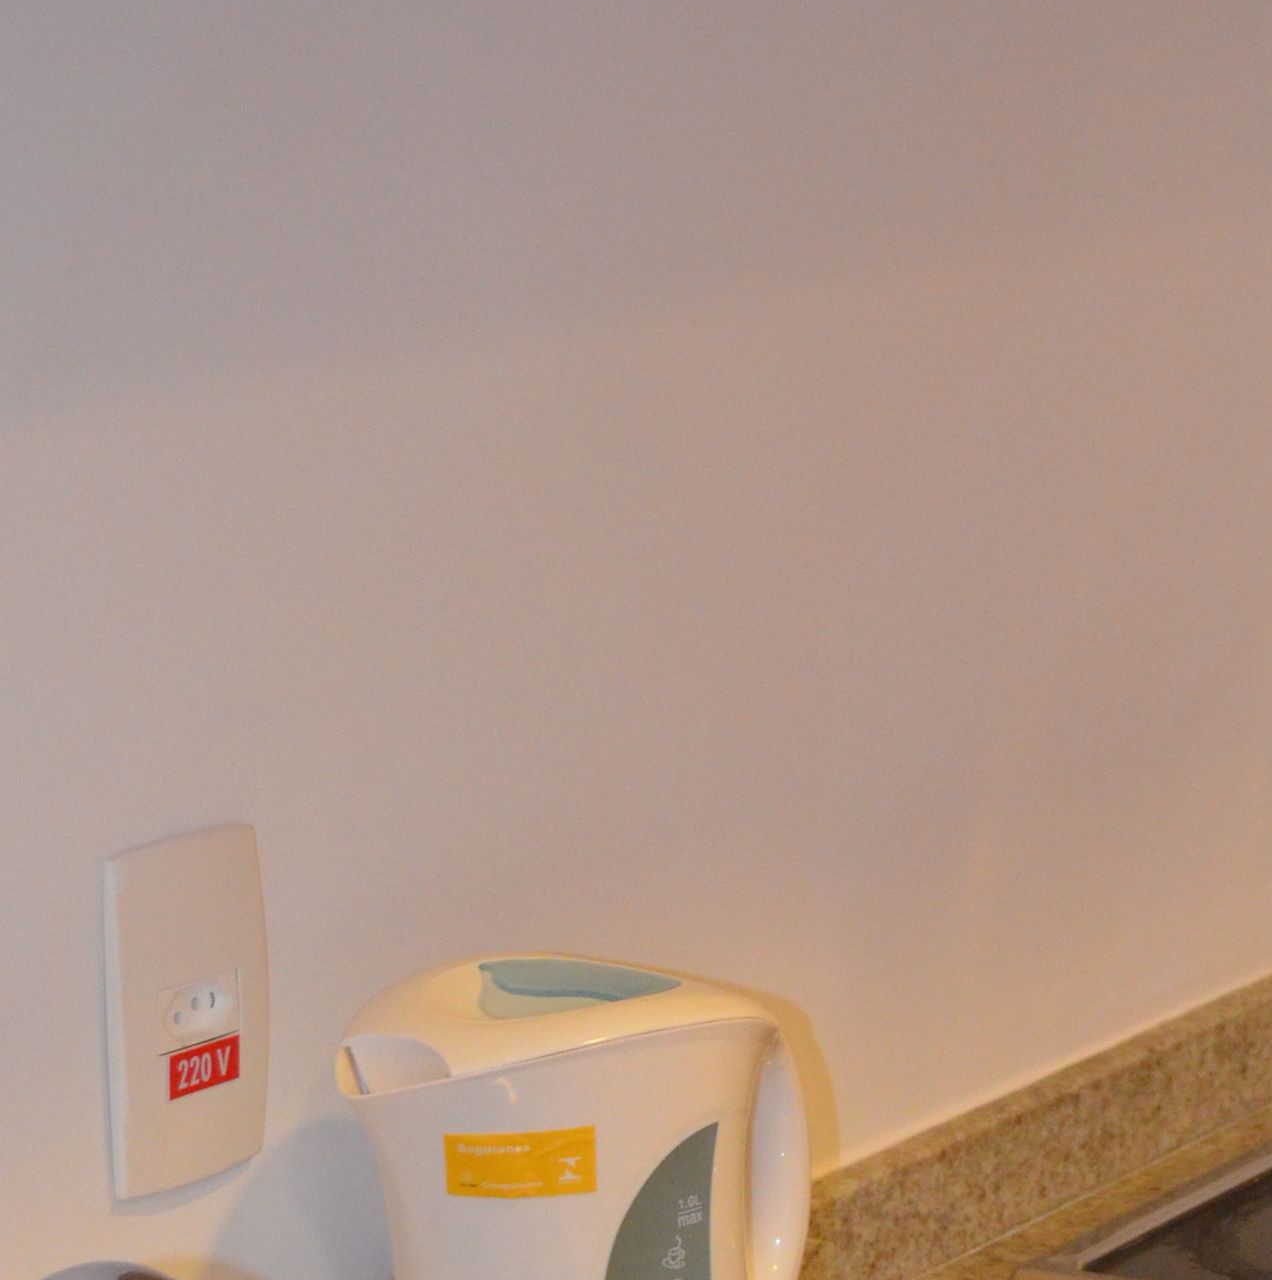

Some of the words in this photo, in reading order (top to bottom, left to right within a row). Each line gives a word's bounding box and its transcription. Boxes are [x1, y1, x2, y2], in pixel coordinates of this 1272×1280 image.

[178, 1053, 212, 1089] 220
[216, 1045, 231, 1077] V
[678, 1194, 702, 1210] 1.0L
[677, 1210, 703, 1228] max
